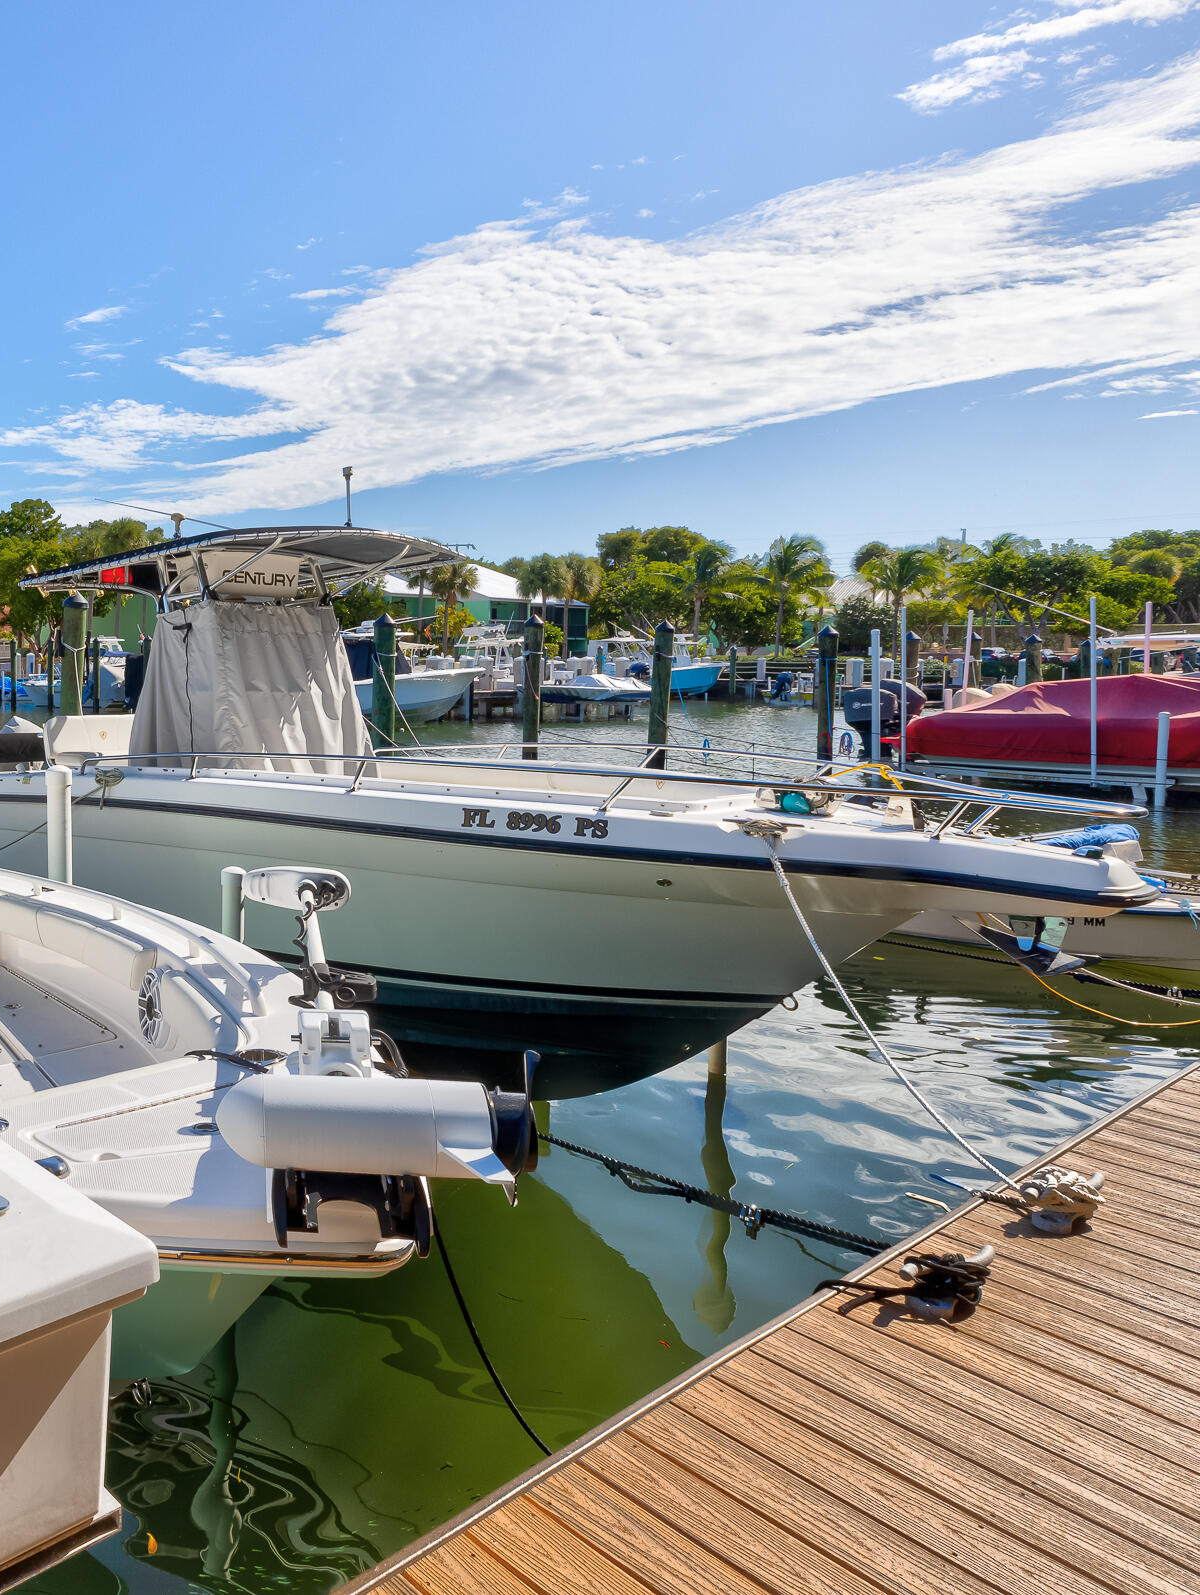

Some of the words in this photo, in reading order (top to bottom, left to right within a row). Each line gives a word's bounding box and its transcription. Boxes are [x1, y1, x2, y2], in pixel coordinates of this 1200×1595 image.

[222, 569, 296, 587] CENTURY
[461, 808, 496, 828] FL
[506, 811, 563, 834] 8996
[573, 817, 609, 839] PS
[1084, 917, 1106, 927] MM
